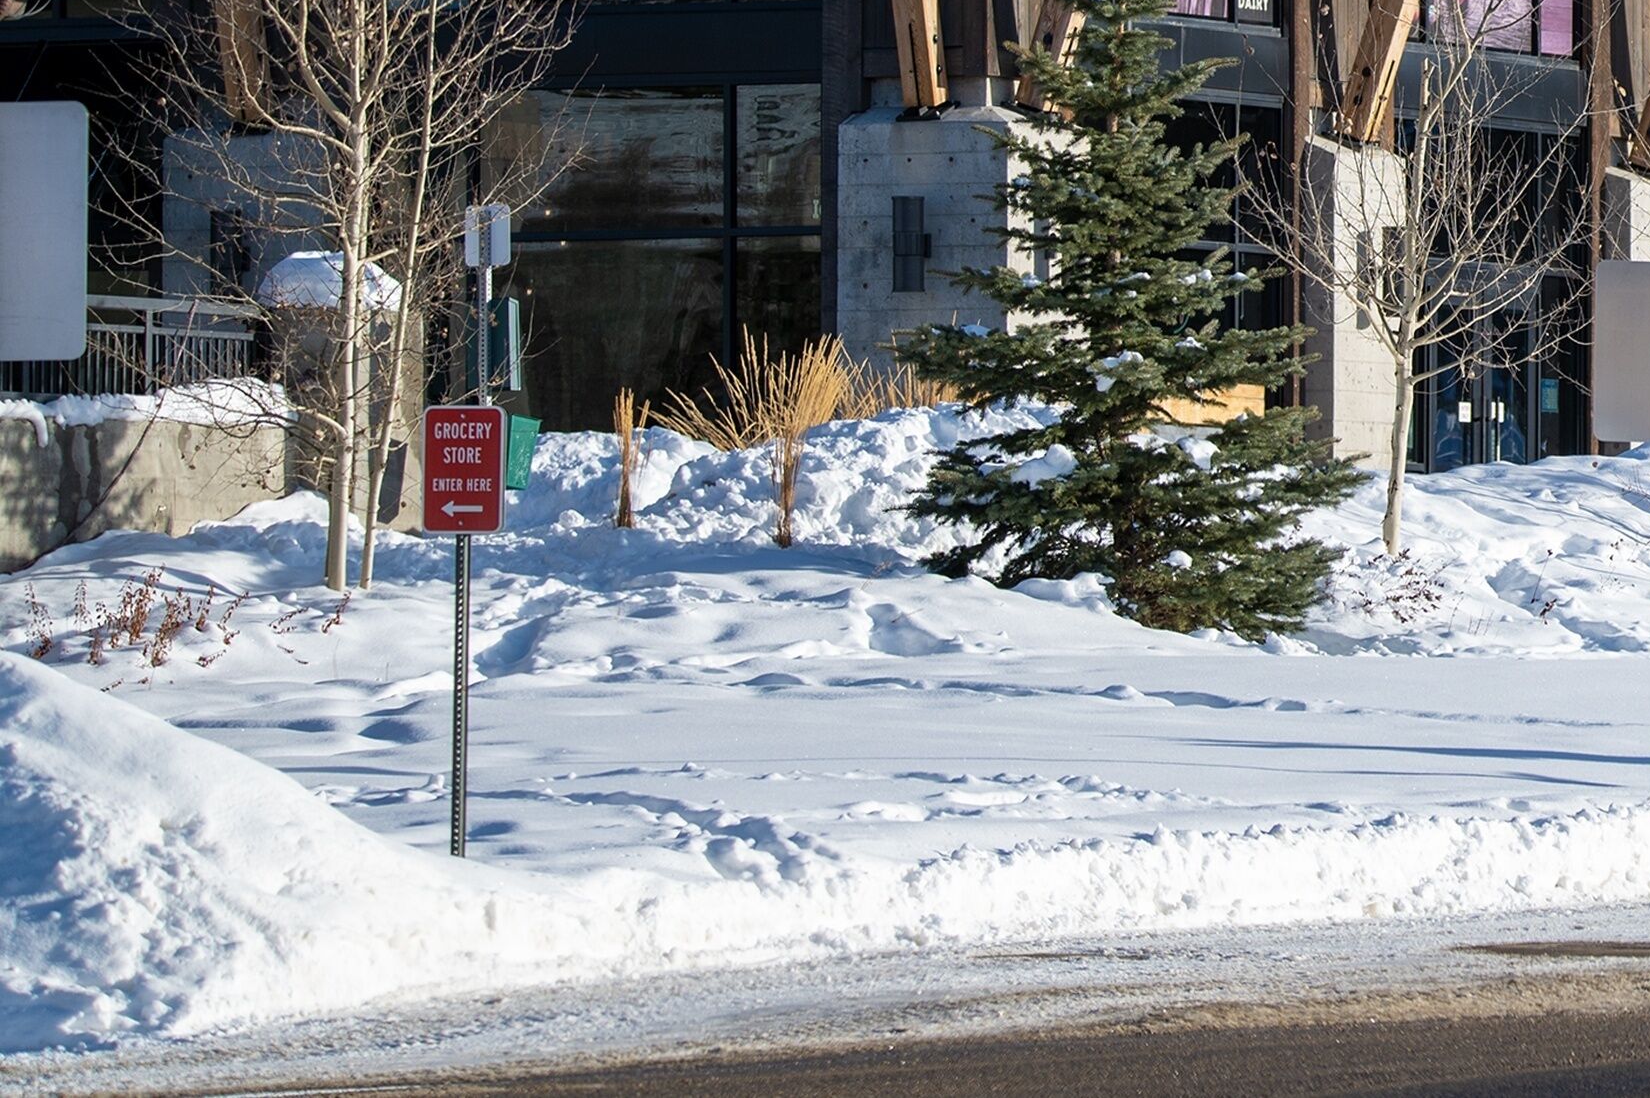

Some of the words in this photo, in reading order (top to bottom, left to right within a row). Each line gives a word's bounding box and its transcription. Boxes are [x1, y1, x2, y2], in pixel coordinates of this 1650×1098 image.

[434, 422, 492, 439] GROCERY
[443, 446, 482, 463] STORE
[432, 478, 463, 492] ENTER
[466, 478, 492, 492] HERE
